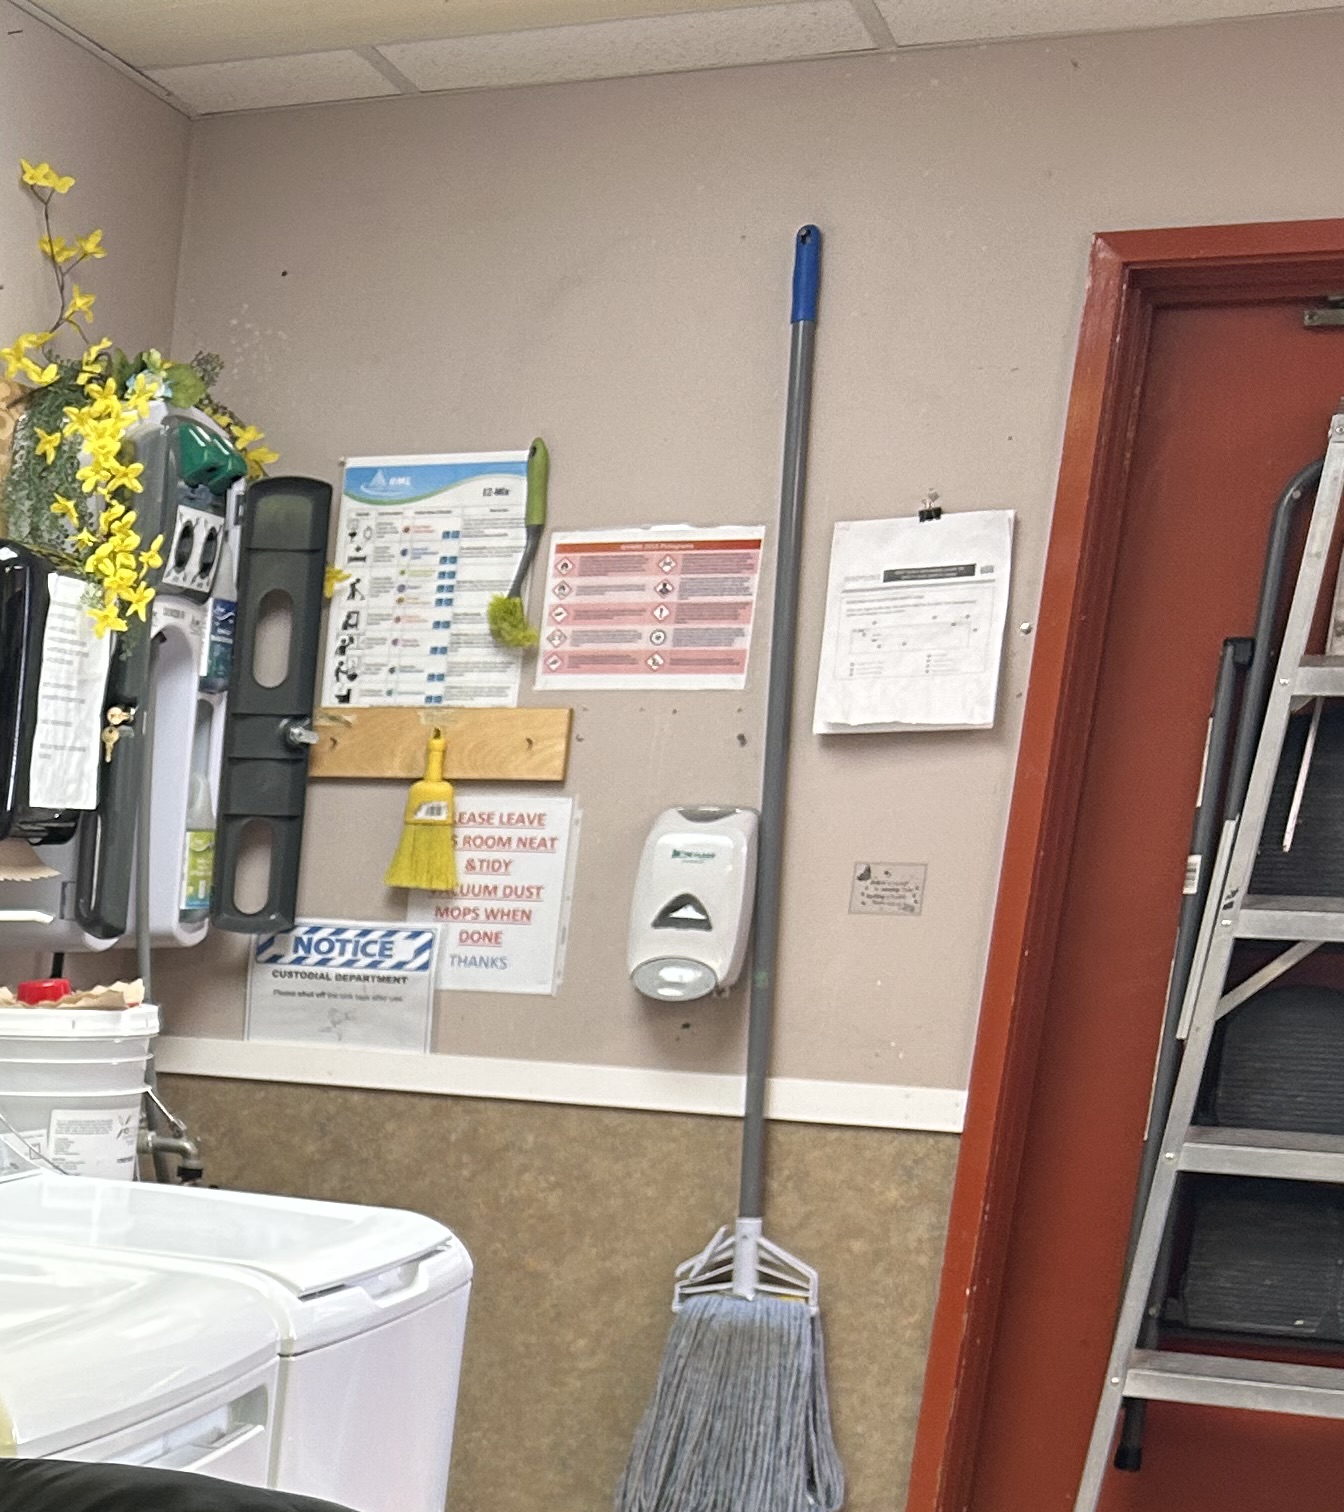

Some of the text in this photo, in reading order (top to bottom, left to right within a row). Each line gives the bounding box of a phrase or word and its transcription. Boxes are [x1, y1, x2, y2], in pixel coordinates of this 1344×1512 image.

[499, 812, 546, 827] LEAVE
[463, 835, 558, 850] ROOM NEAT
[465, 859, 513, 874] &TIDY
[503, 884, 544, 899] DUST
[434, 906, 532, 922] MOPS WHEN
[459, 930, 502, 946] DONE
[291, 935, 394, 959] NOTICE
[449, 954, 507, 970] THANKS
[272, 970, 408, 984] CUSTODIAL DEPARTMENT
